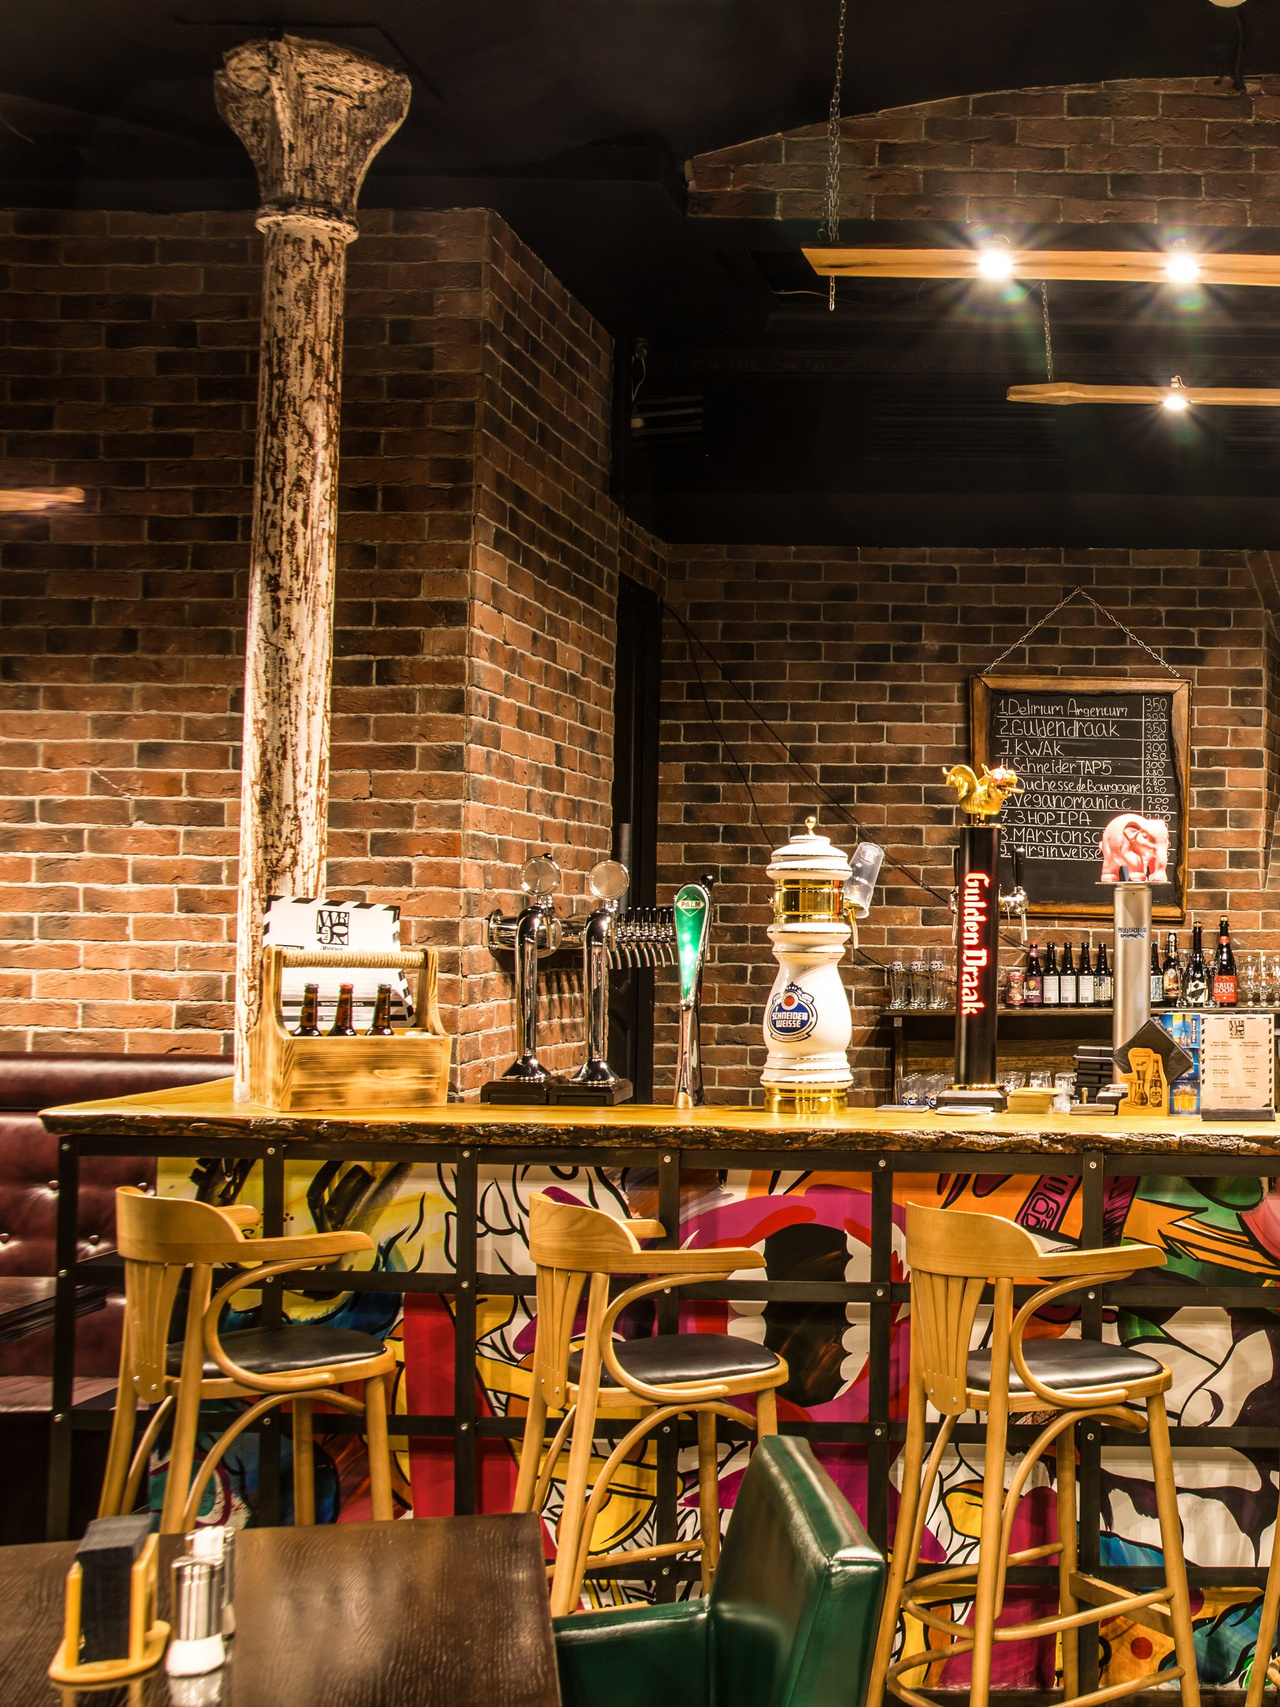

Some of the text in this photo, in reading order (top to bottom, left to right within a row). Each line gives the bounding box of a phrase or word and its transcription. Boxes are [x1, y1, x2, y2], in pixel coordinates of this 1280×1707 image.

[1145, 697, 1167, 712] 350
[1146, 712, 1166, 720] 300
[1145, 722, 1167, 734] 350
[1145, 742, 1167, 753] 300
[1145, 752, 1167, 761] 250
[1013, 757, 1077, 774] Schneider
[1145, 760, 1166, 769] 300
[1146, 786, 1167, 794] 250
[1146, 796, 1169, 804] 200
[1148, 804, 1169, 812] 150
[1028, 811, 1055, 825] HOP
[1056, 811, 1092, 825] IPA
[961, 872, 990, 1015] Gulden Draak
[772, 1010, 808, 1021] SCHNEIDER
[775, 1019, 801, 1028] WEISSE
